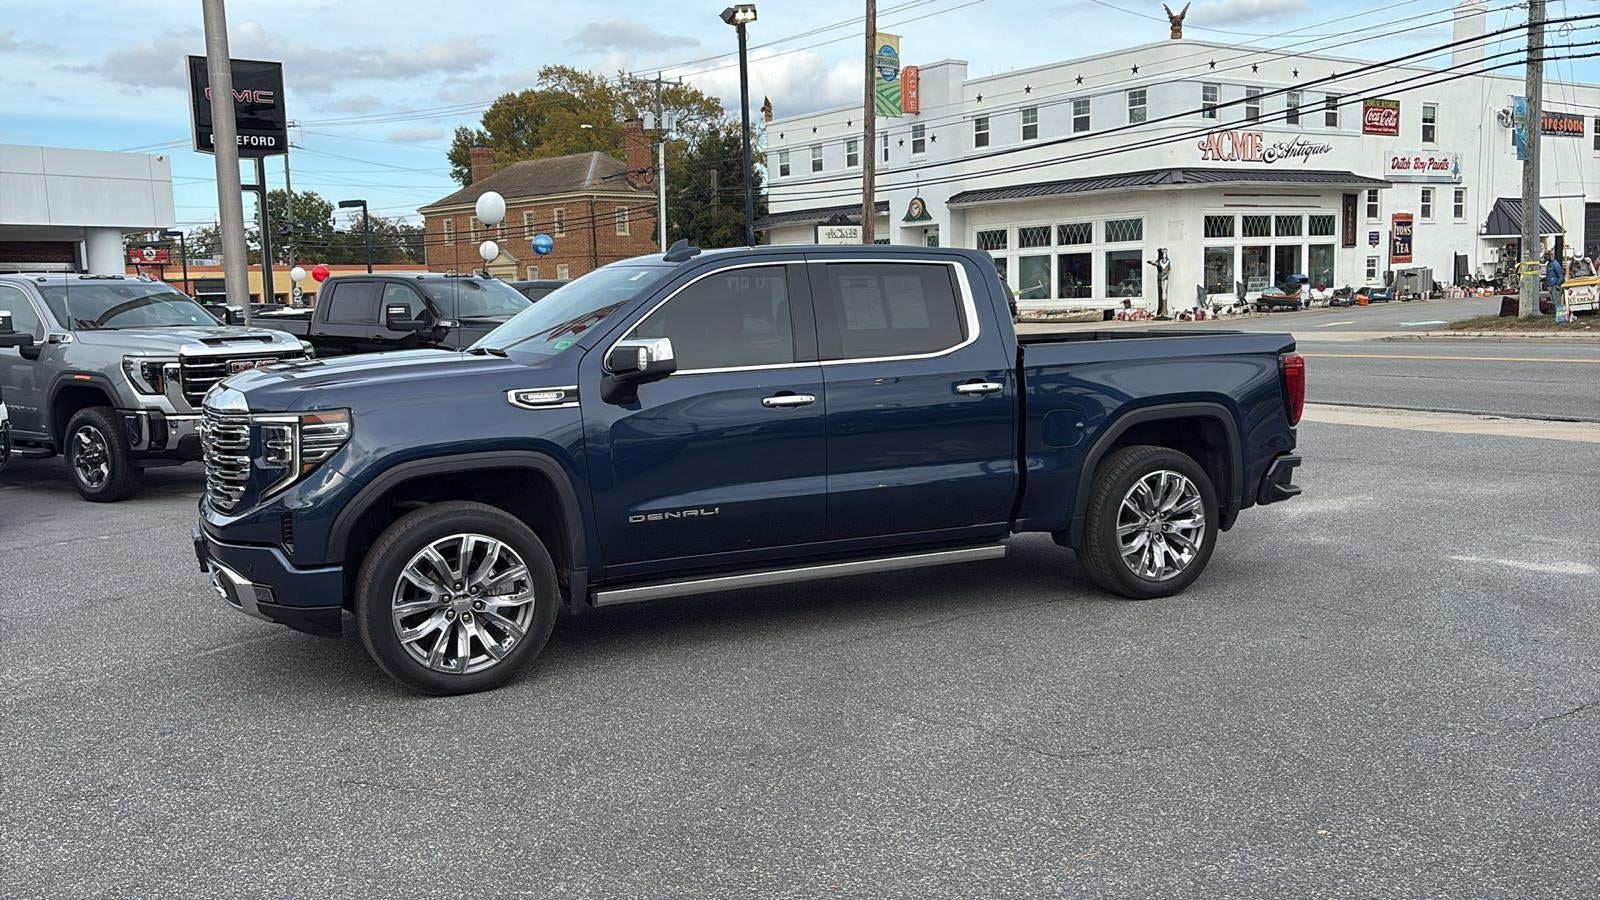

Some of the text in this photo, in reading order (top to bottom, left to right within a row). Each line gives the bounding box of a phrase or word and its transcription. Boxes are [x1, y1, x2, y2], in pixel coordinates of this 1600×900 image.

[908, 69, 917, 111] ACME
[1197, 130, 1264, 162] ACME
[1391, 156, 1450, 174] Dutch Boy Paints
[1395, 241, 1410, 254] TEA
[628, 507, 720, 523] DENALI
